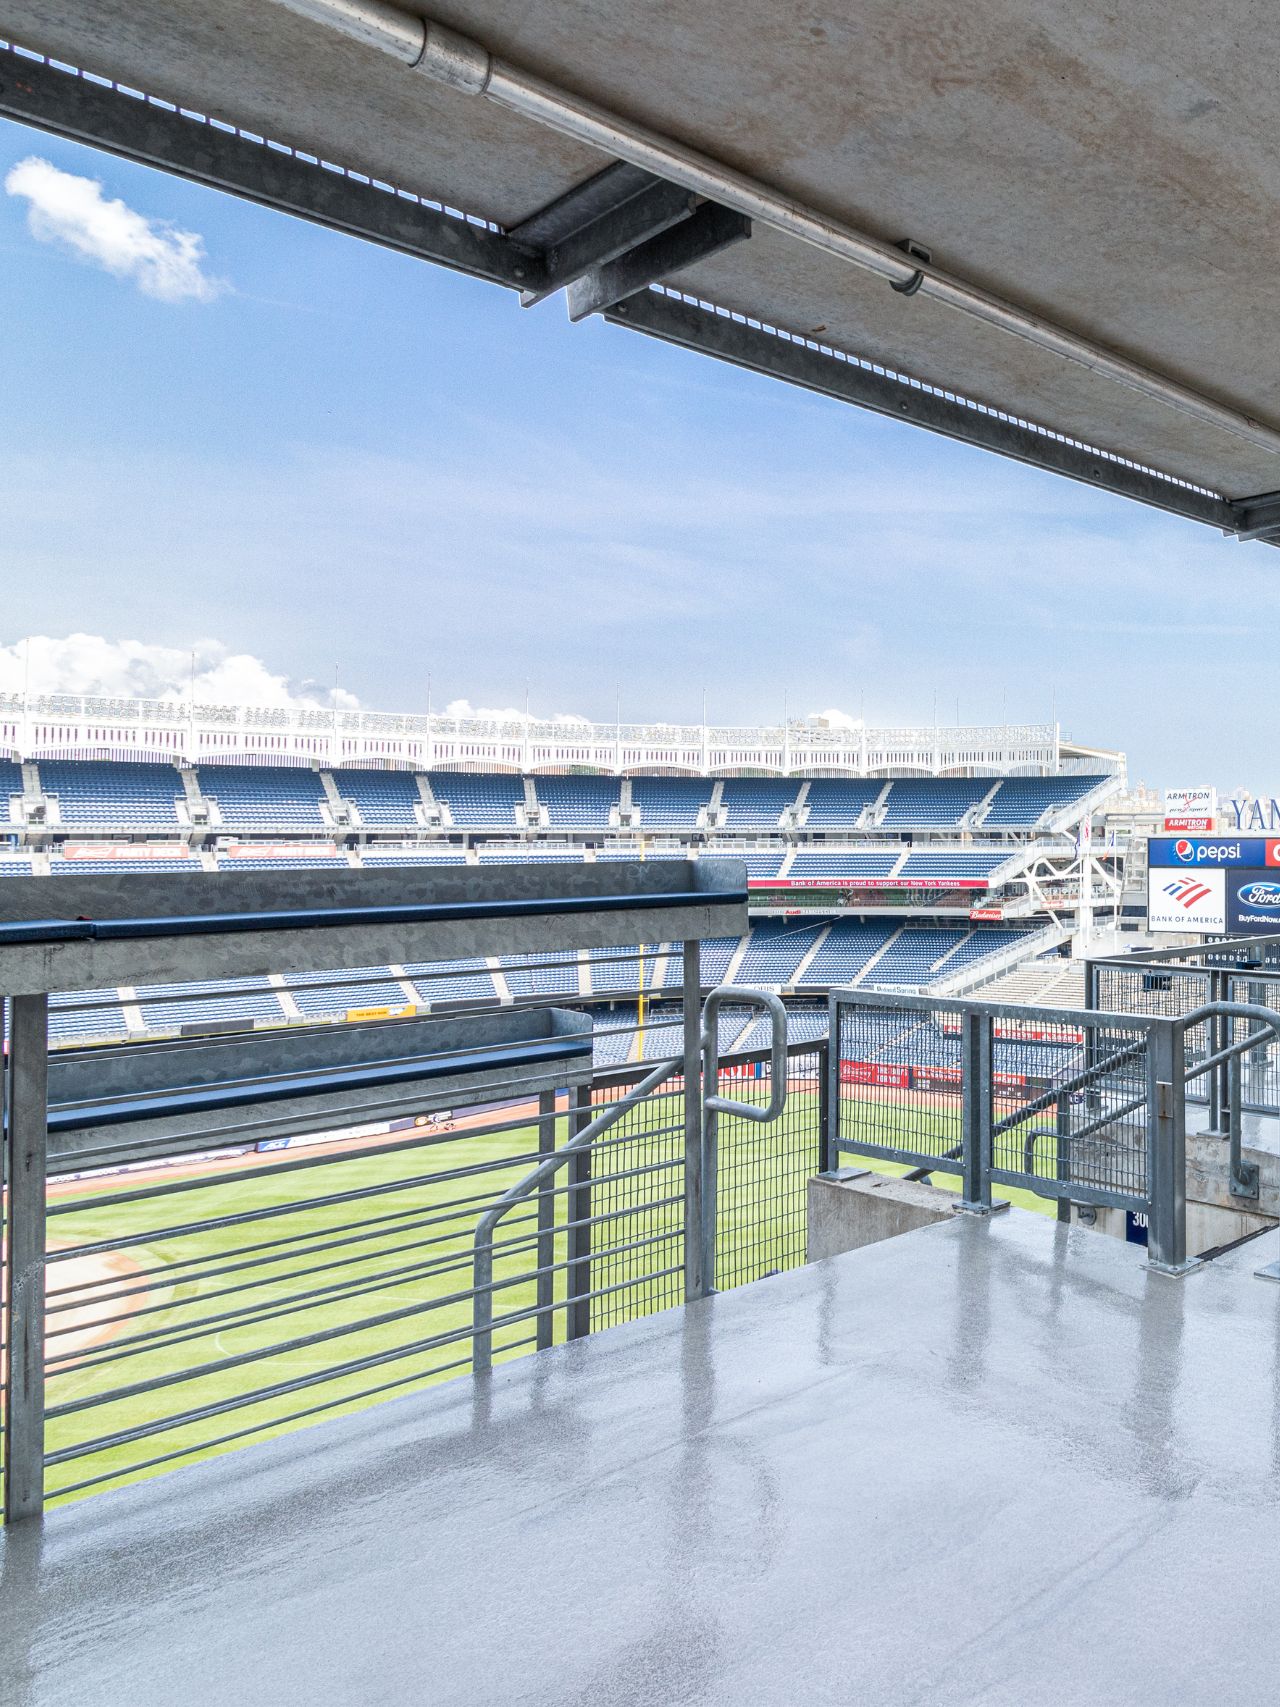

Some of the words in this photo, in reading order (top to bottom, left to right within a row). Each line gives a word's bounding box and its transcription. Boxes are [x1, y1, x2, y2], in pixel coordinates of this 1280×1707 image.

[1167, 792, 1210, 800] ARMITRON
[1196, 843, 1241, 862] pepsi
[970, 910, 1002, 920] Budweiser
[1151, 915, 1173, 923] BANK
[1187, 916, 1224, 924] AMERICA
